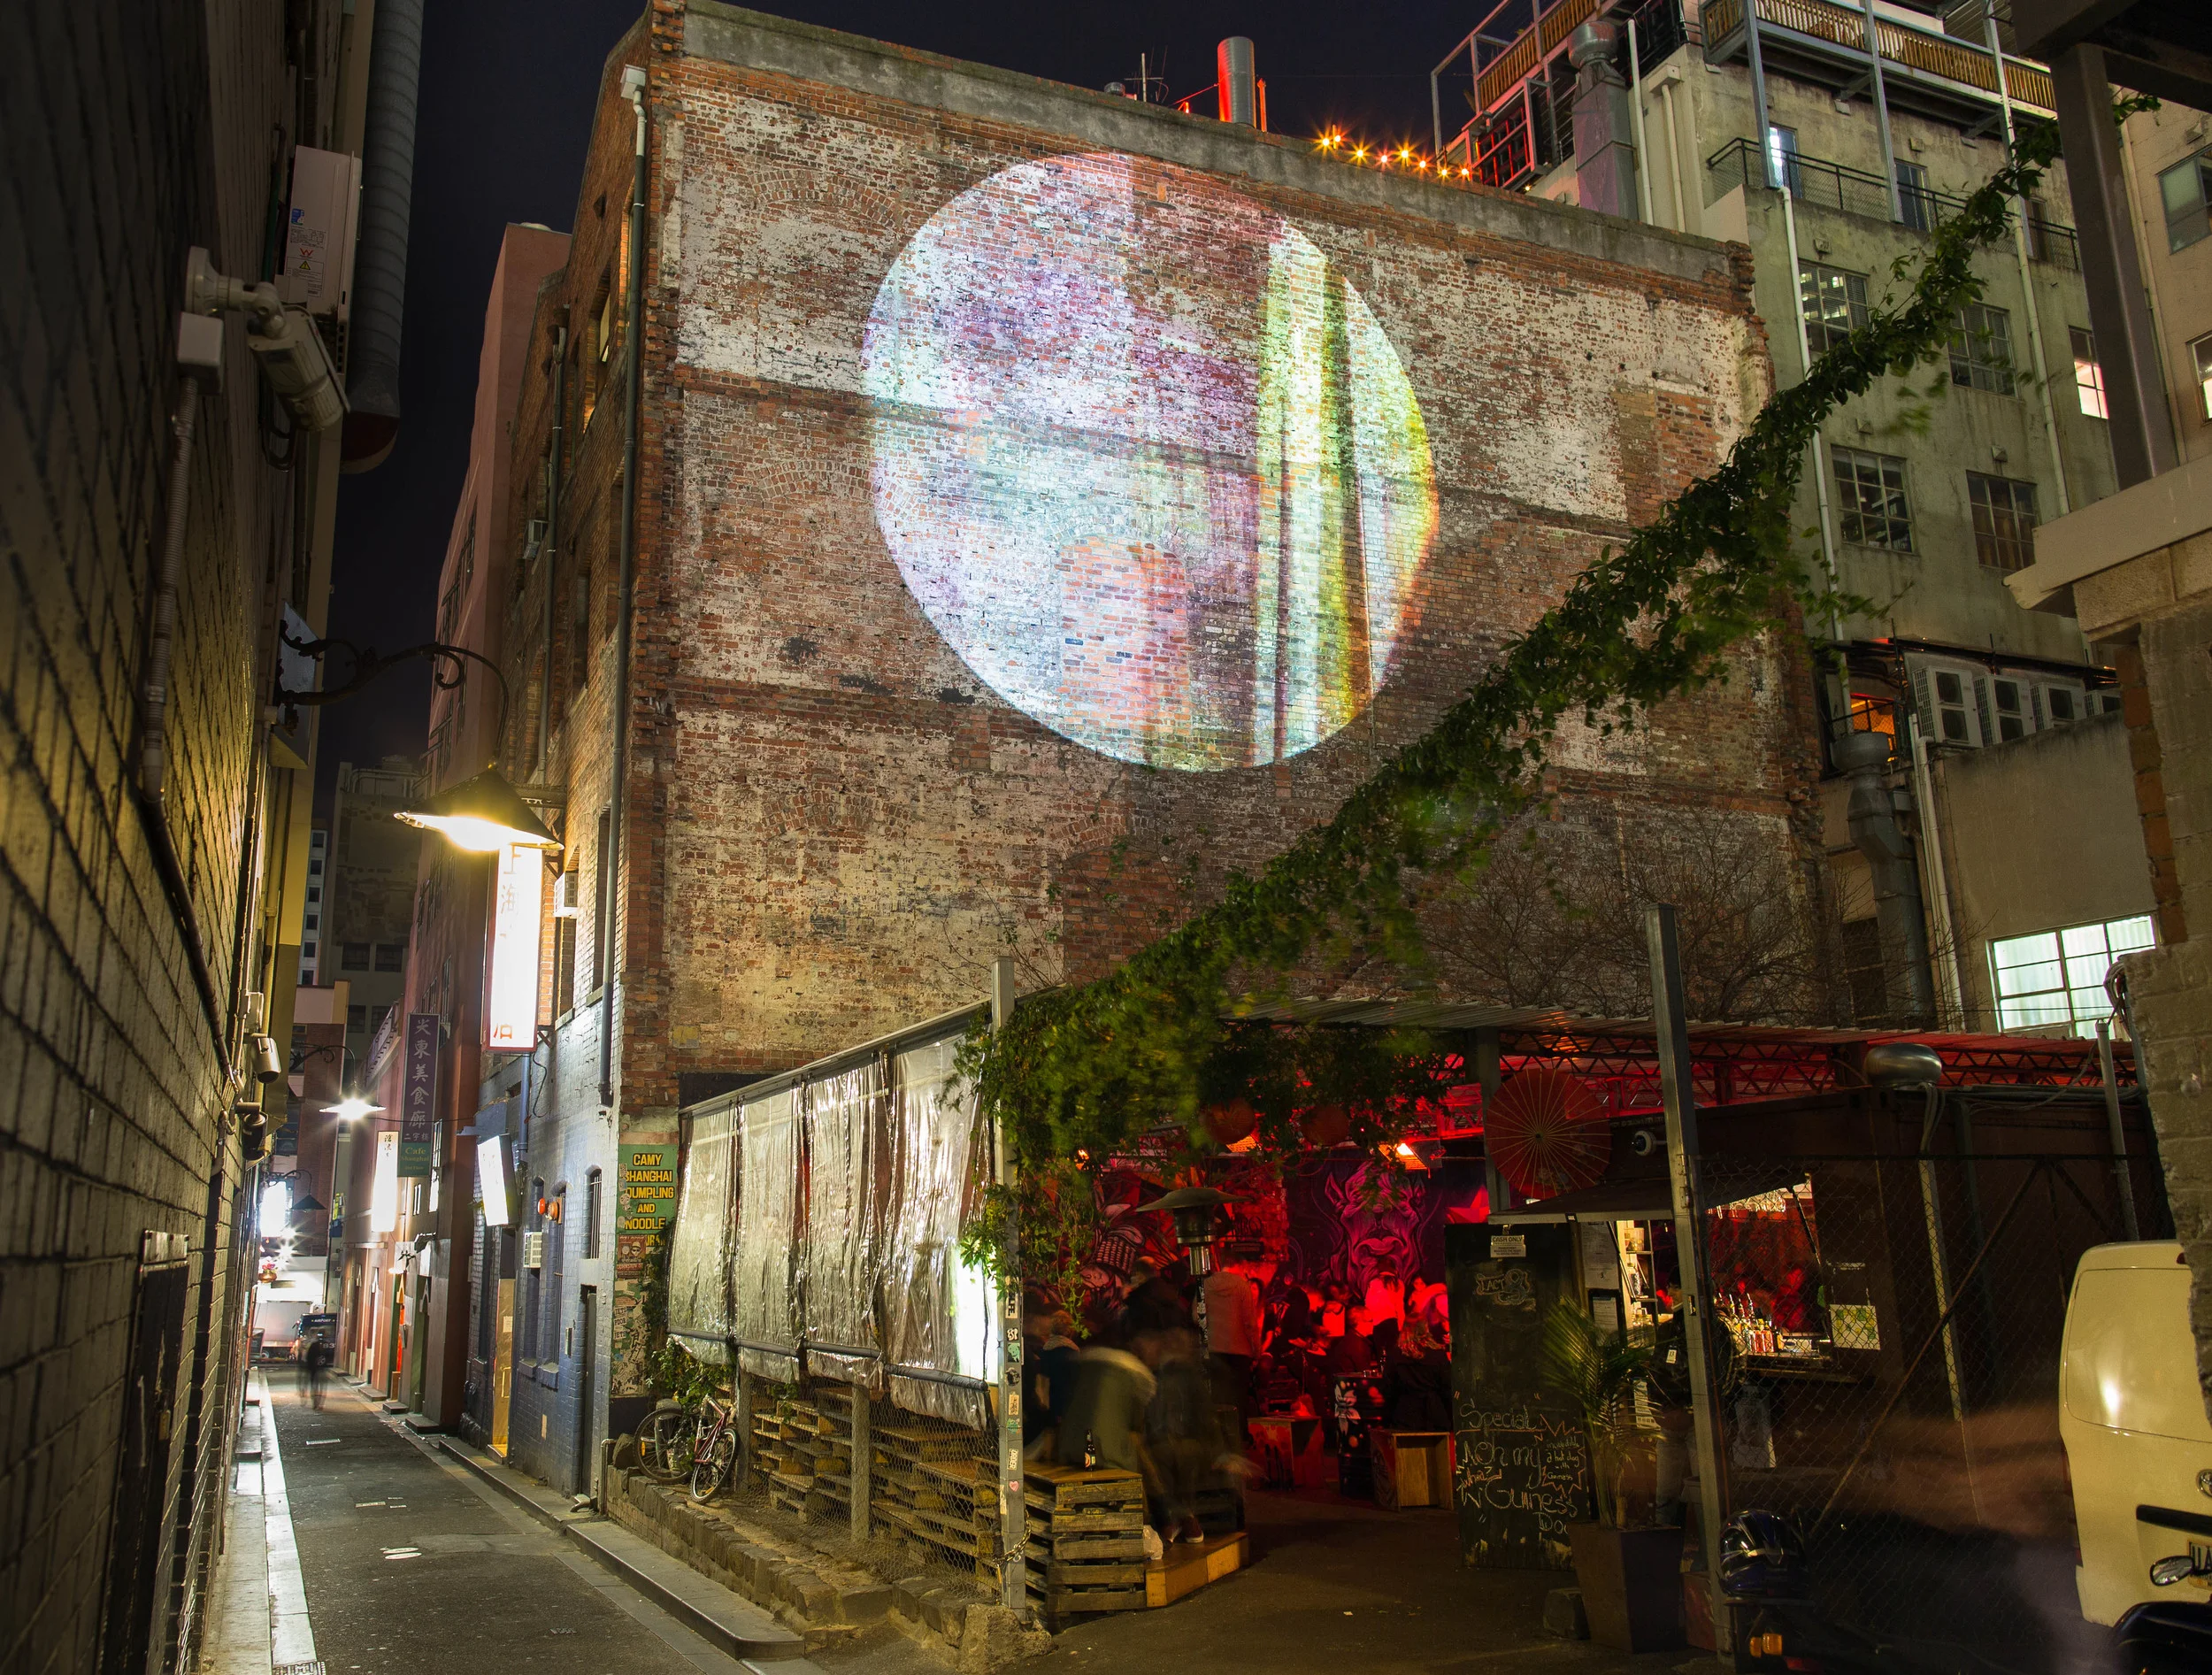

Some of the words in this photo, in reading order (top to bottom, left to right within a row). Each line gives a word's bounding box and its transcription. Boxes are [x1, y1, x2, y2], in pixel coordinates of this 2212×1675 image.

[633, 1153, 663, 1166] CAMY
[636, 1202, 656, 1214] AND
[624, 1218, 666, 1230] NOODLE
